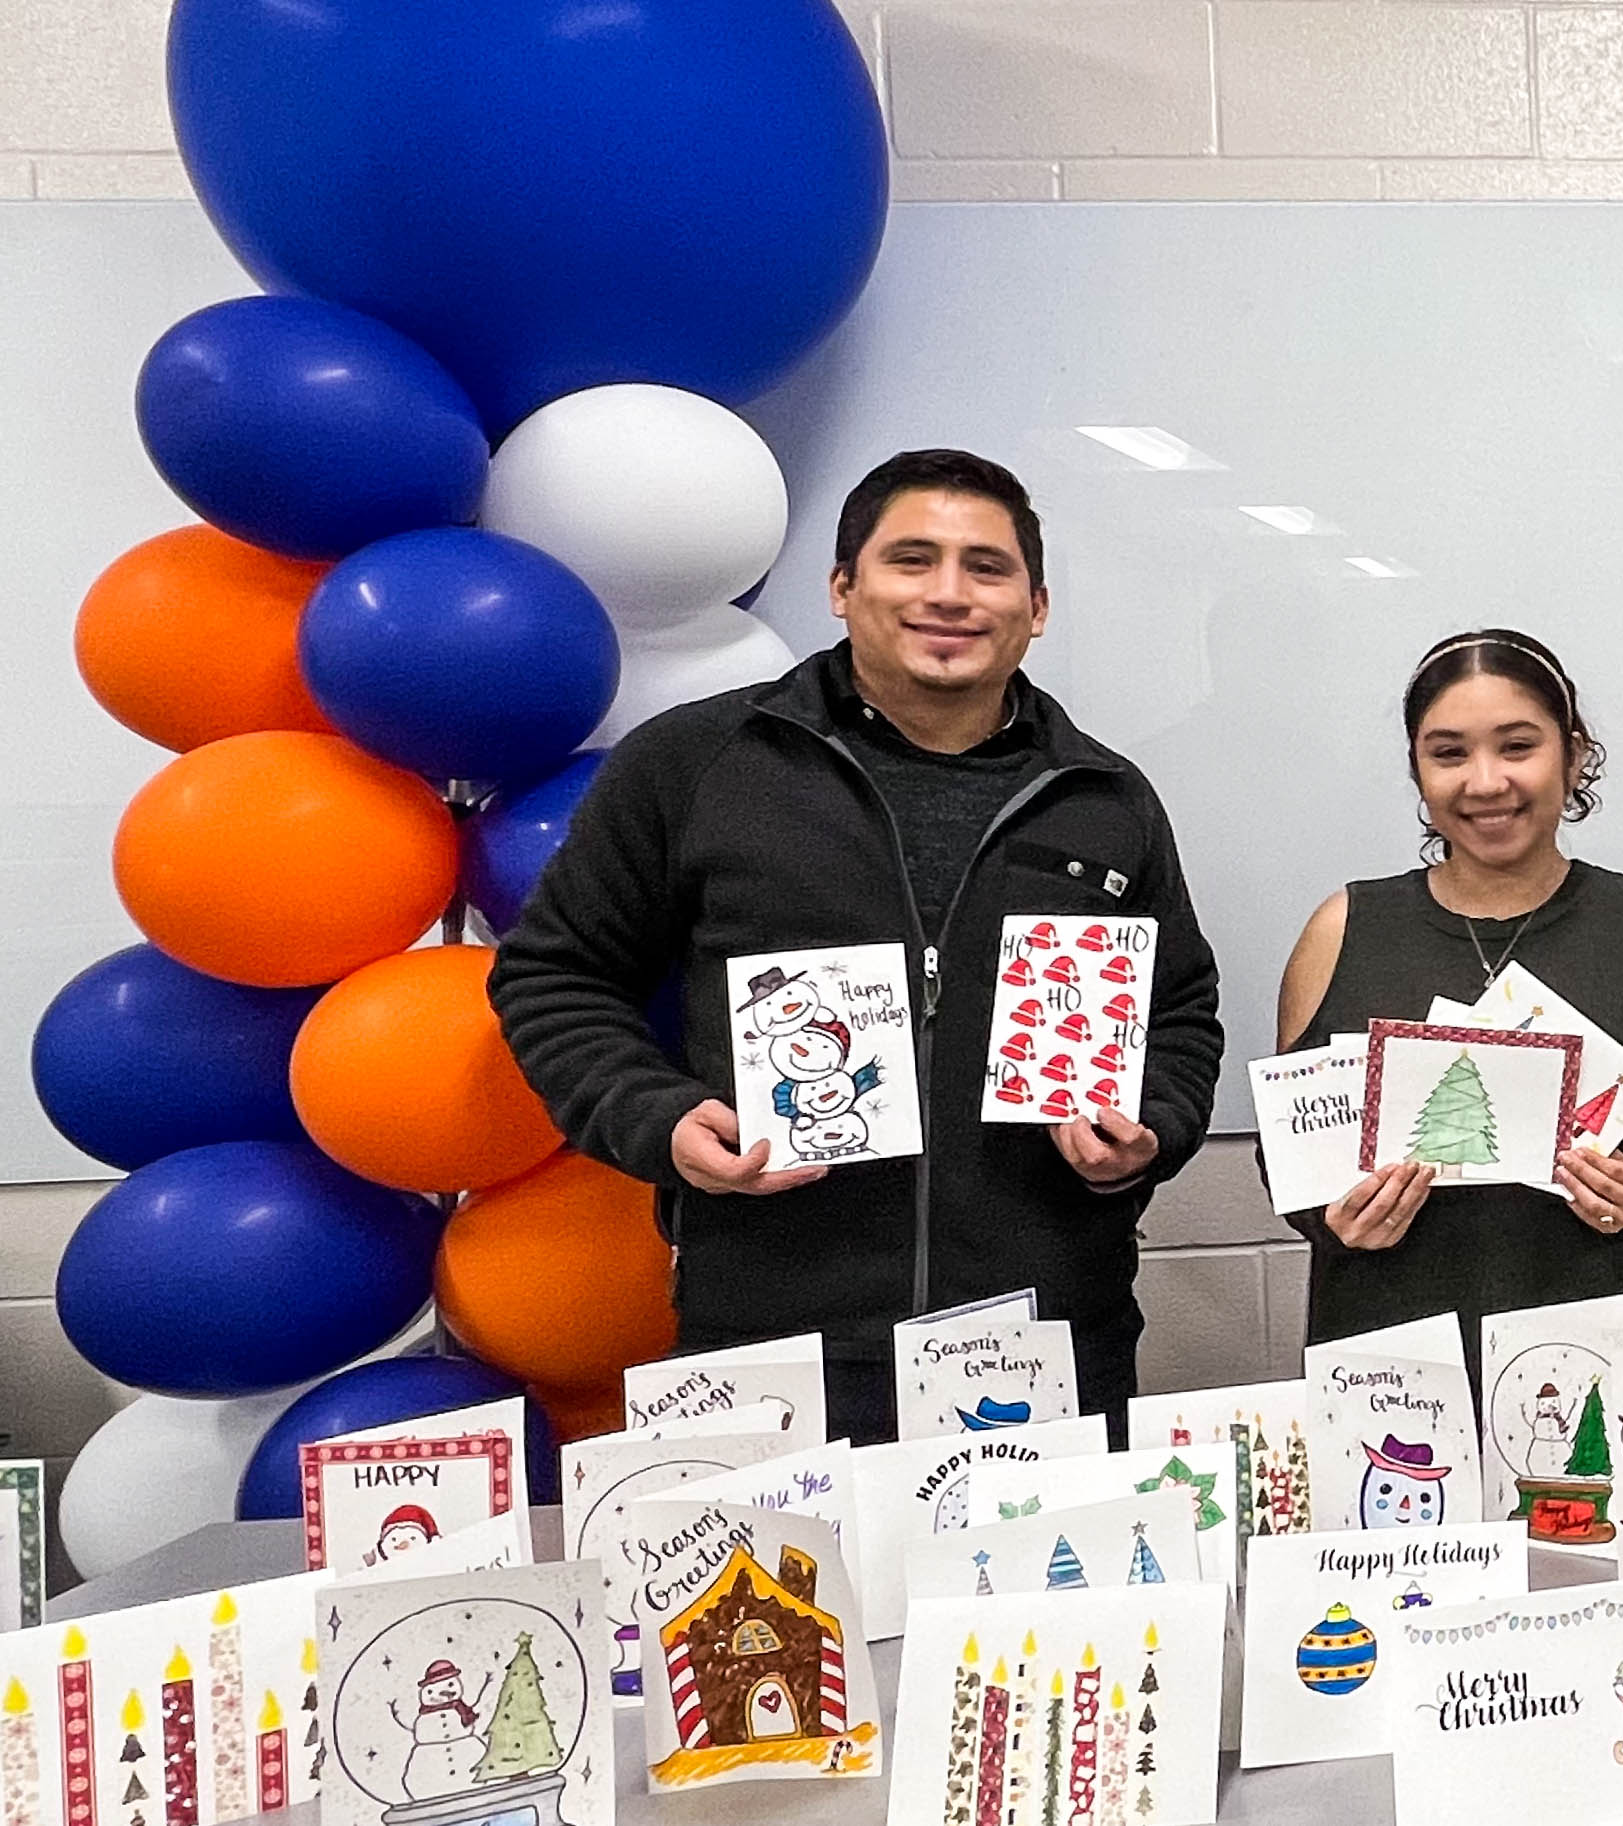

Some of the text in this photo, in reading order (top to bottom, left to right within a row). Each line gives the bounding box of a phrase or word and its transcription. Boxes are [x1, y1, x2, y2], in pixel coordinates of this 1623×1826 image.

[1116, 925, 1149, 952] HO
[840, 980, 894, 1005] Happy
[1046, 985, 1081, 1011] HO
[849, 1006, 908, 1029] holidays
[1113, 1022, 1147, 1048] HO
[987, 1061, 1019, 1087] HO
[1292, 1094, 1350, 1114] Merry
[924, 1331, 1002, 1363] Season's
[1332, 1366, 1404, 1393] Season's
[629, 1372, 711, 1429] Season's
[354, 1464, 440, 1488] HAPPY
[793, 1470, 832, 1500] the
[916, 1449, 971, 1501] HAPPY
[638, 1506, 728, 1575] Season's
[645, 1522, 754, 1611] Greetings
[1316, 1540, 1502, 1579] Happy Holidays
[1440, 1670, 1528, 1699] Merry
[1439, 1688, 1584, 1731] Christmas
